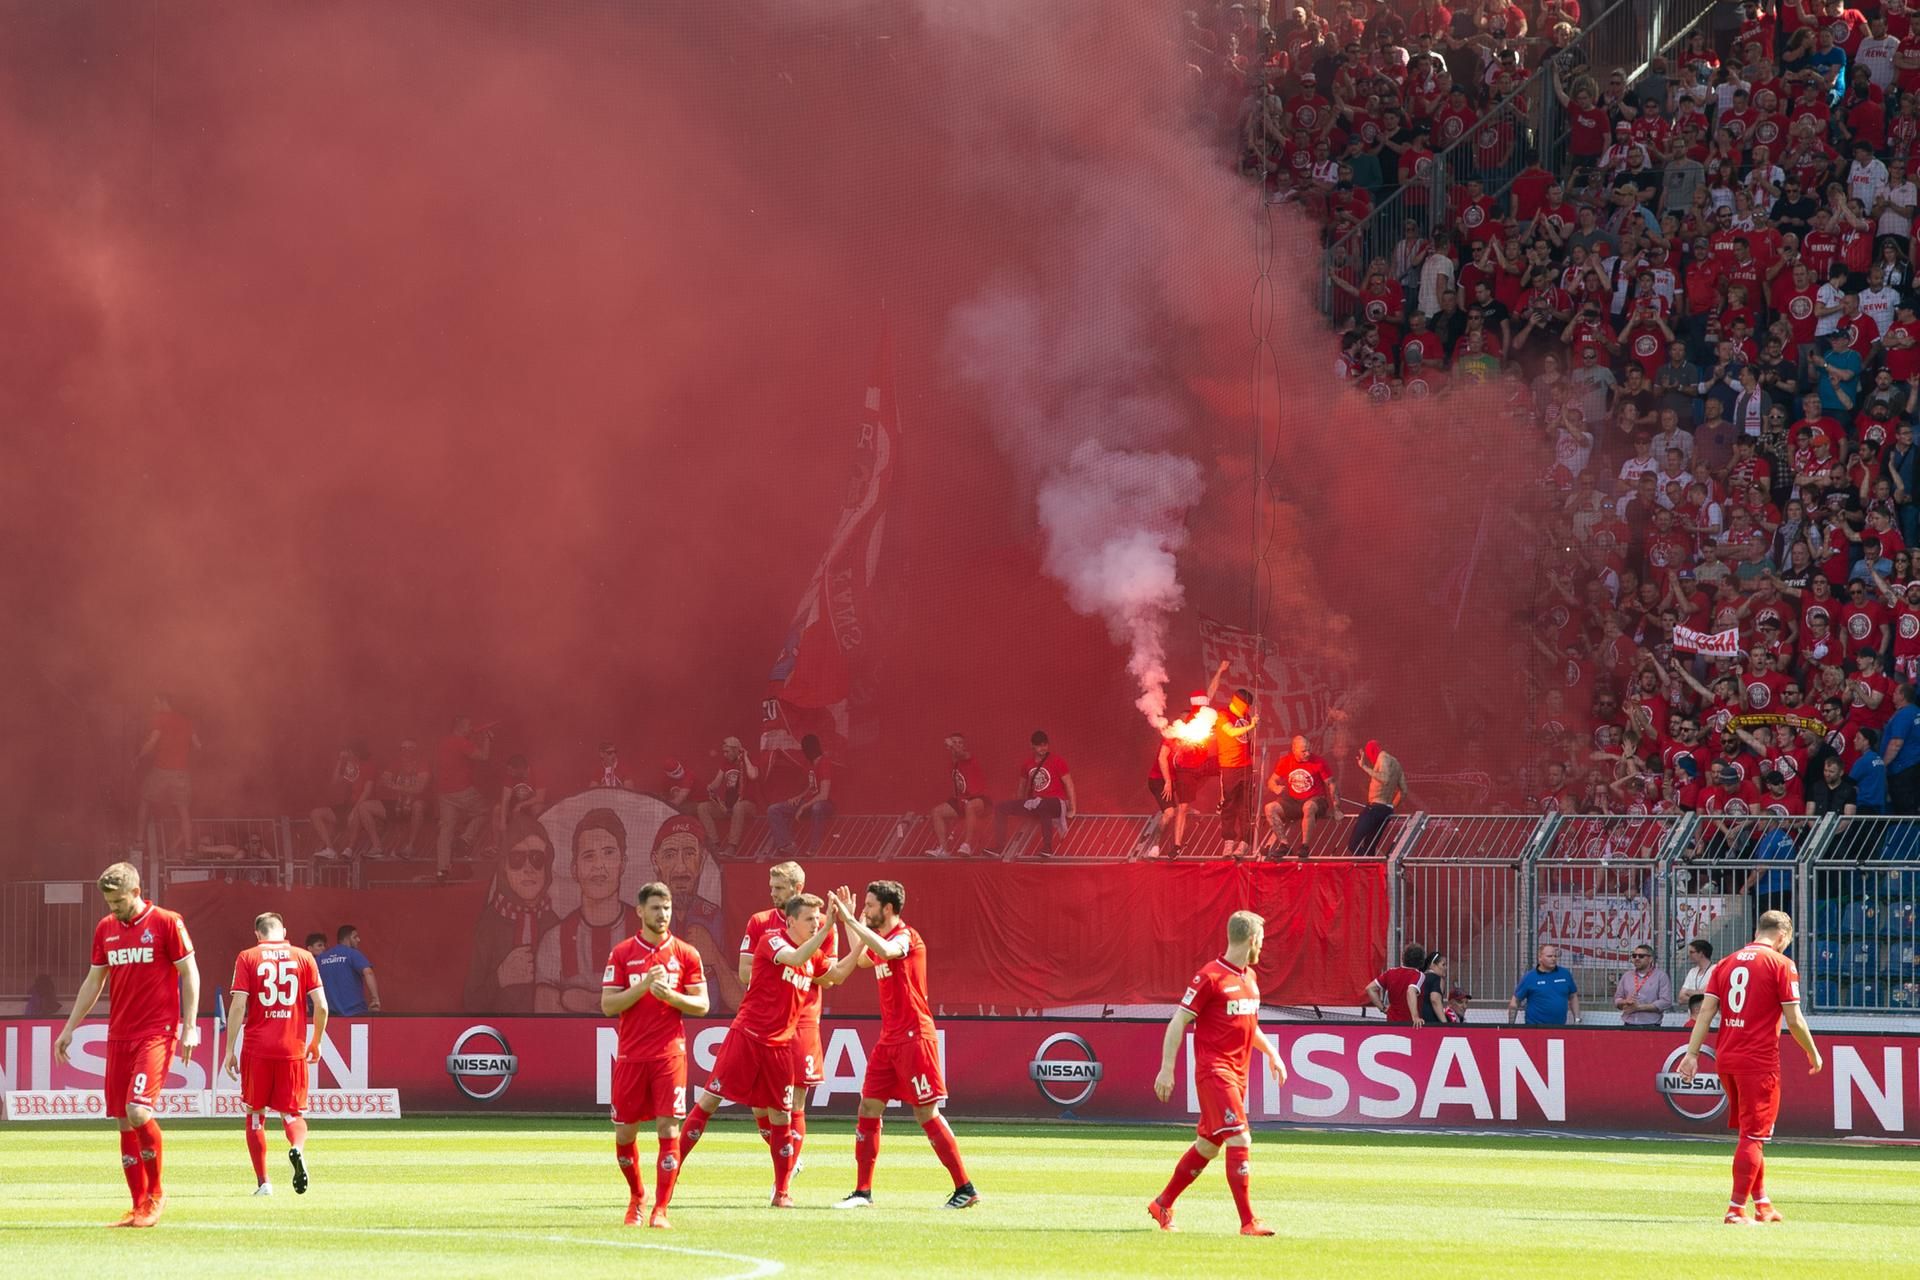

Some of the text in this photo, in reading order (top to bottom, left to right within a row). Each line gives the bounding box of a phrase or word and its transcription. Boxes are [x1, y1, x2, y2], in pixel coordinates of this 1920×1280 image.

[1811, 244, 1836, 252] REWE
[1863, 302, 1888, 312] REWE
[107, 947, 154, 966] REWE
[257, 961, 299, 1007] 35
[1728, 966, 1750, 1014] 8
[453, 1058, 512, 1071] NISSAN
[805, 1055, 815, 1076] 3
[1036, 1064, 1096, 1078] NISSAN
[133, 1073, 147, 1095] 9
[911, 1073, 931, 1097] 14
